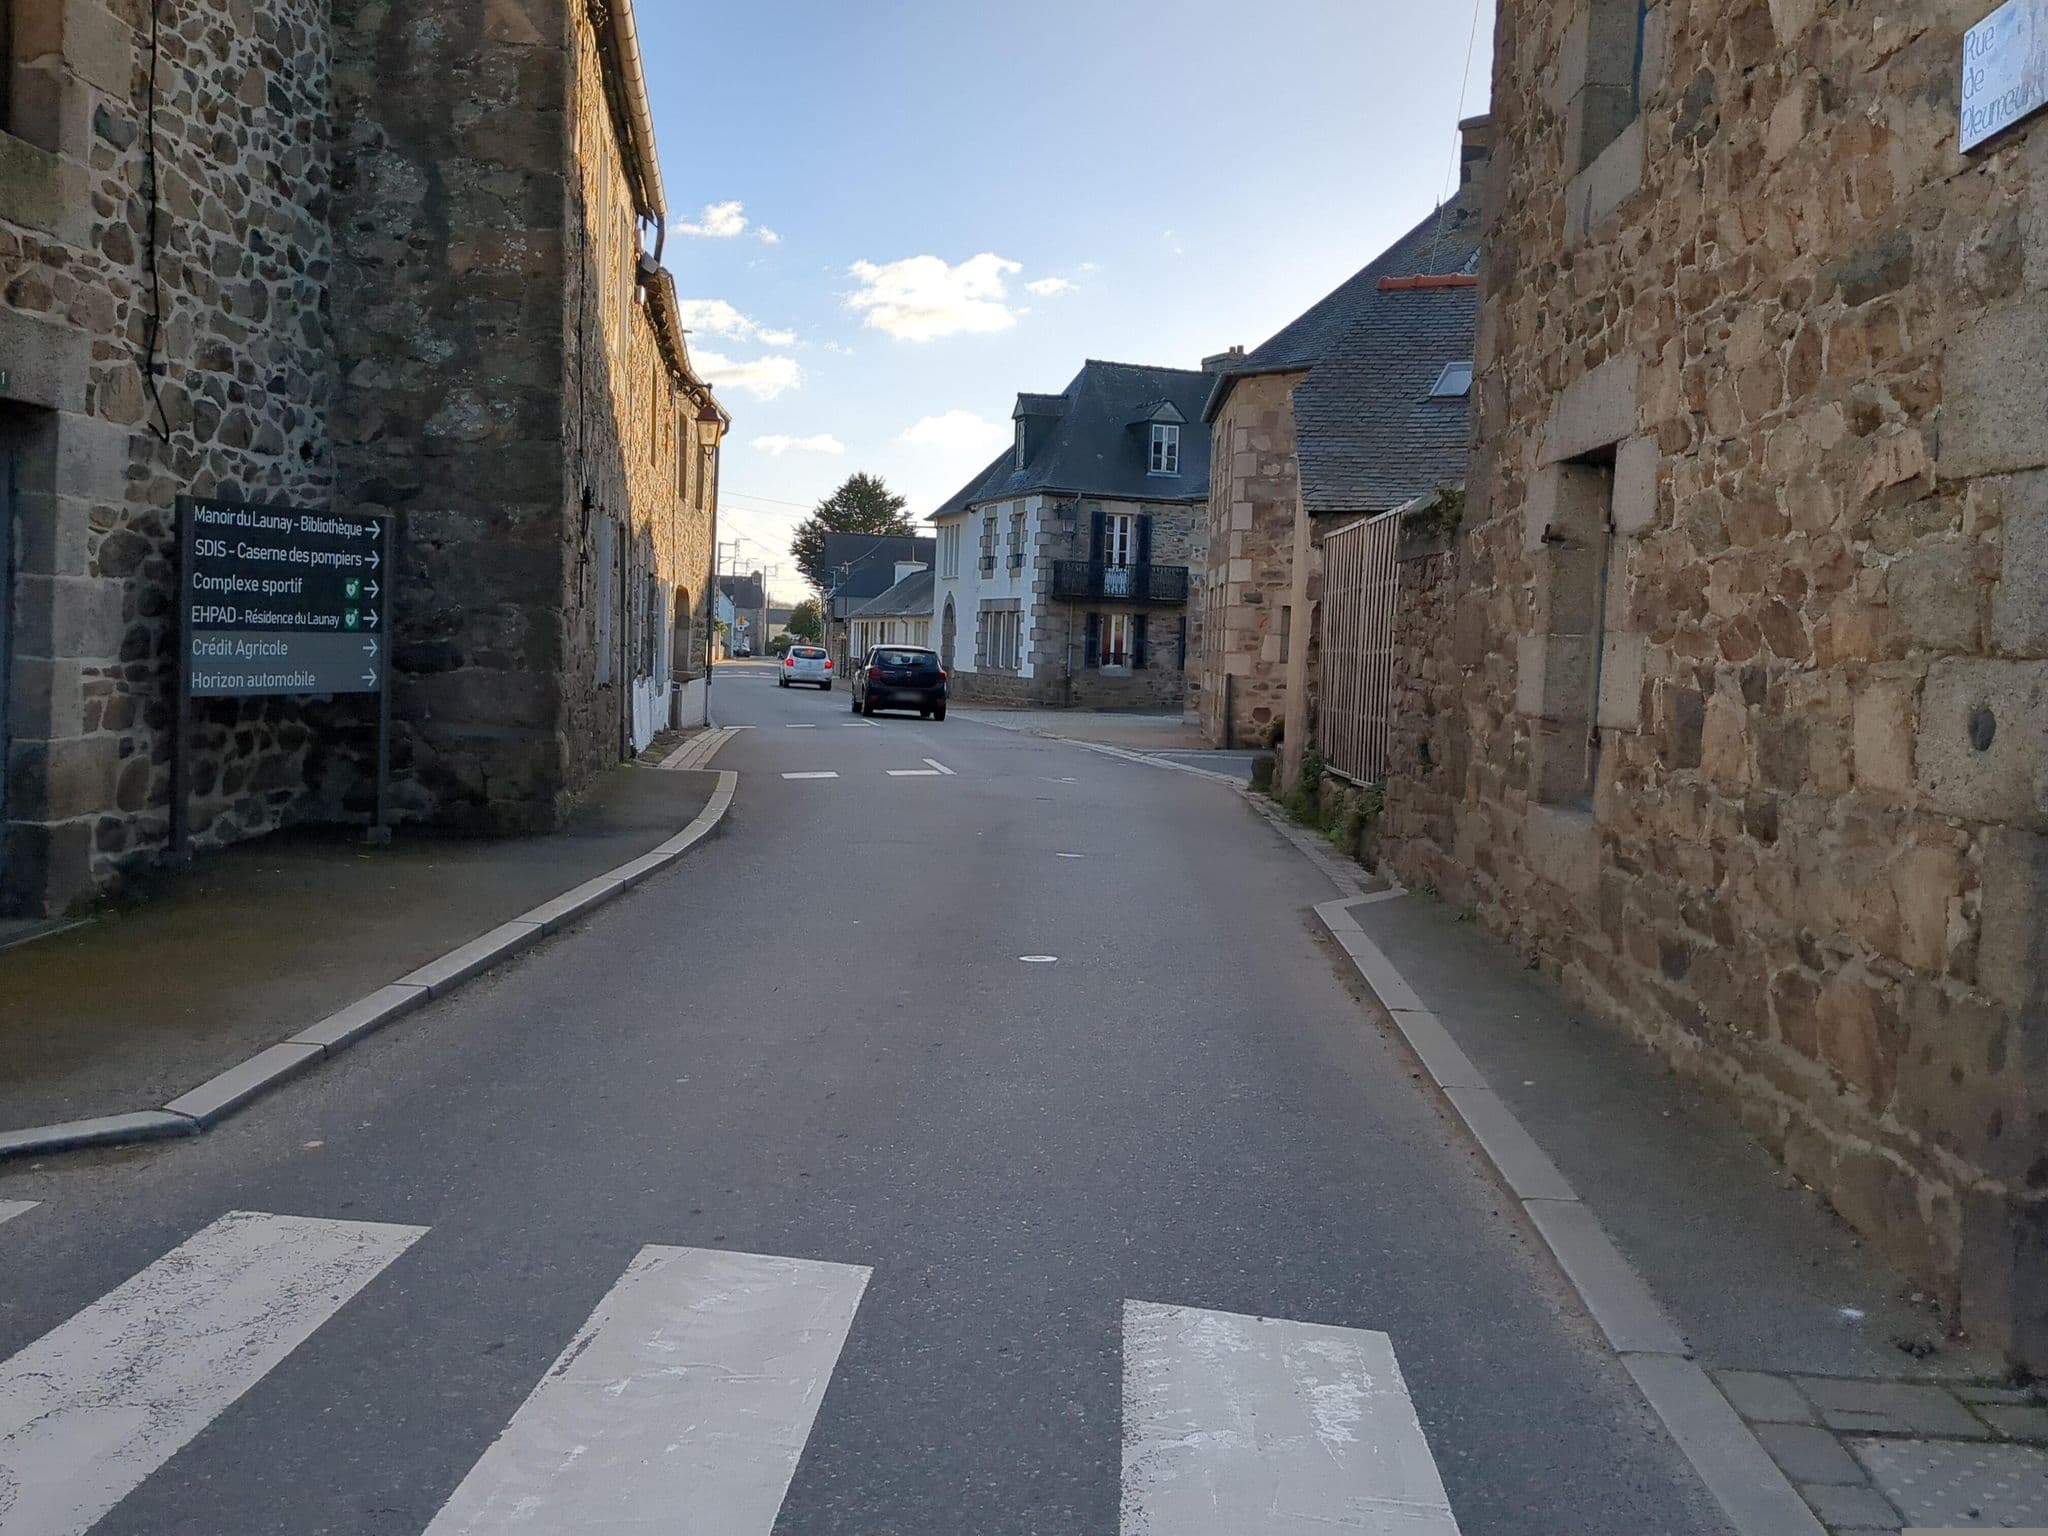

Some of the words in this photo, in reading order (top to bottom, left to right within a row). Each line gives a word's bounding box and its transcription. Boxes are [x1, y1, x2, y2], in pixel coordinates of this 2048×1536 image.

[1965, 26, 1994, 65] Rue
[1964, 67, 1984, 99] de
[194, 505, 234, 523] Manoir
[237, 510, 250, 526] du
[253, 511, 292, 534] Launay
[301, 516, 362, 539] Bibliothèque
[195, 539, 226, 557] SDIS
[238, 542, 286, 561] Caserne
[289, 547, 309, 563] des
[311, 551, 362, 568] pompiers
[193, 572, 258, 594] Complexe
[262, 578, 303, 596] sportif
[192, 606, 236, 623] EHPAD
[245, 608, 293, 625] Résidence
[295, 611, 306, 625] du
[308, 612, 339, 628] Launay
[192, 637, 232, 656] Crédit
[235, 640, 288, 659] Agricole
[192, 671, 244, 689] Horizon
[247, 670, 316, 687] automobile
